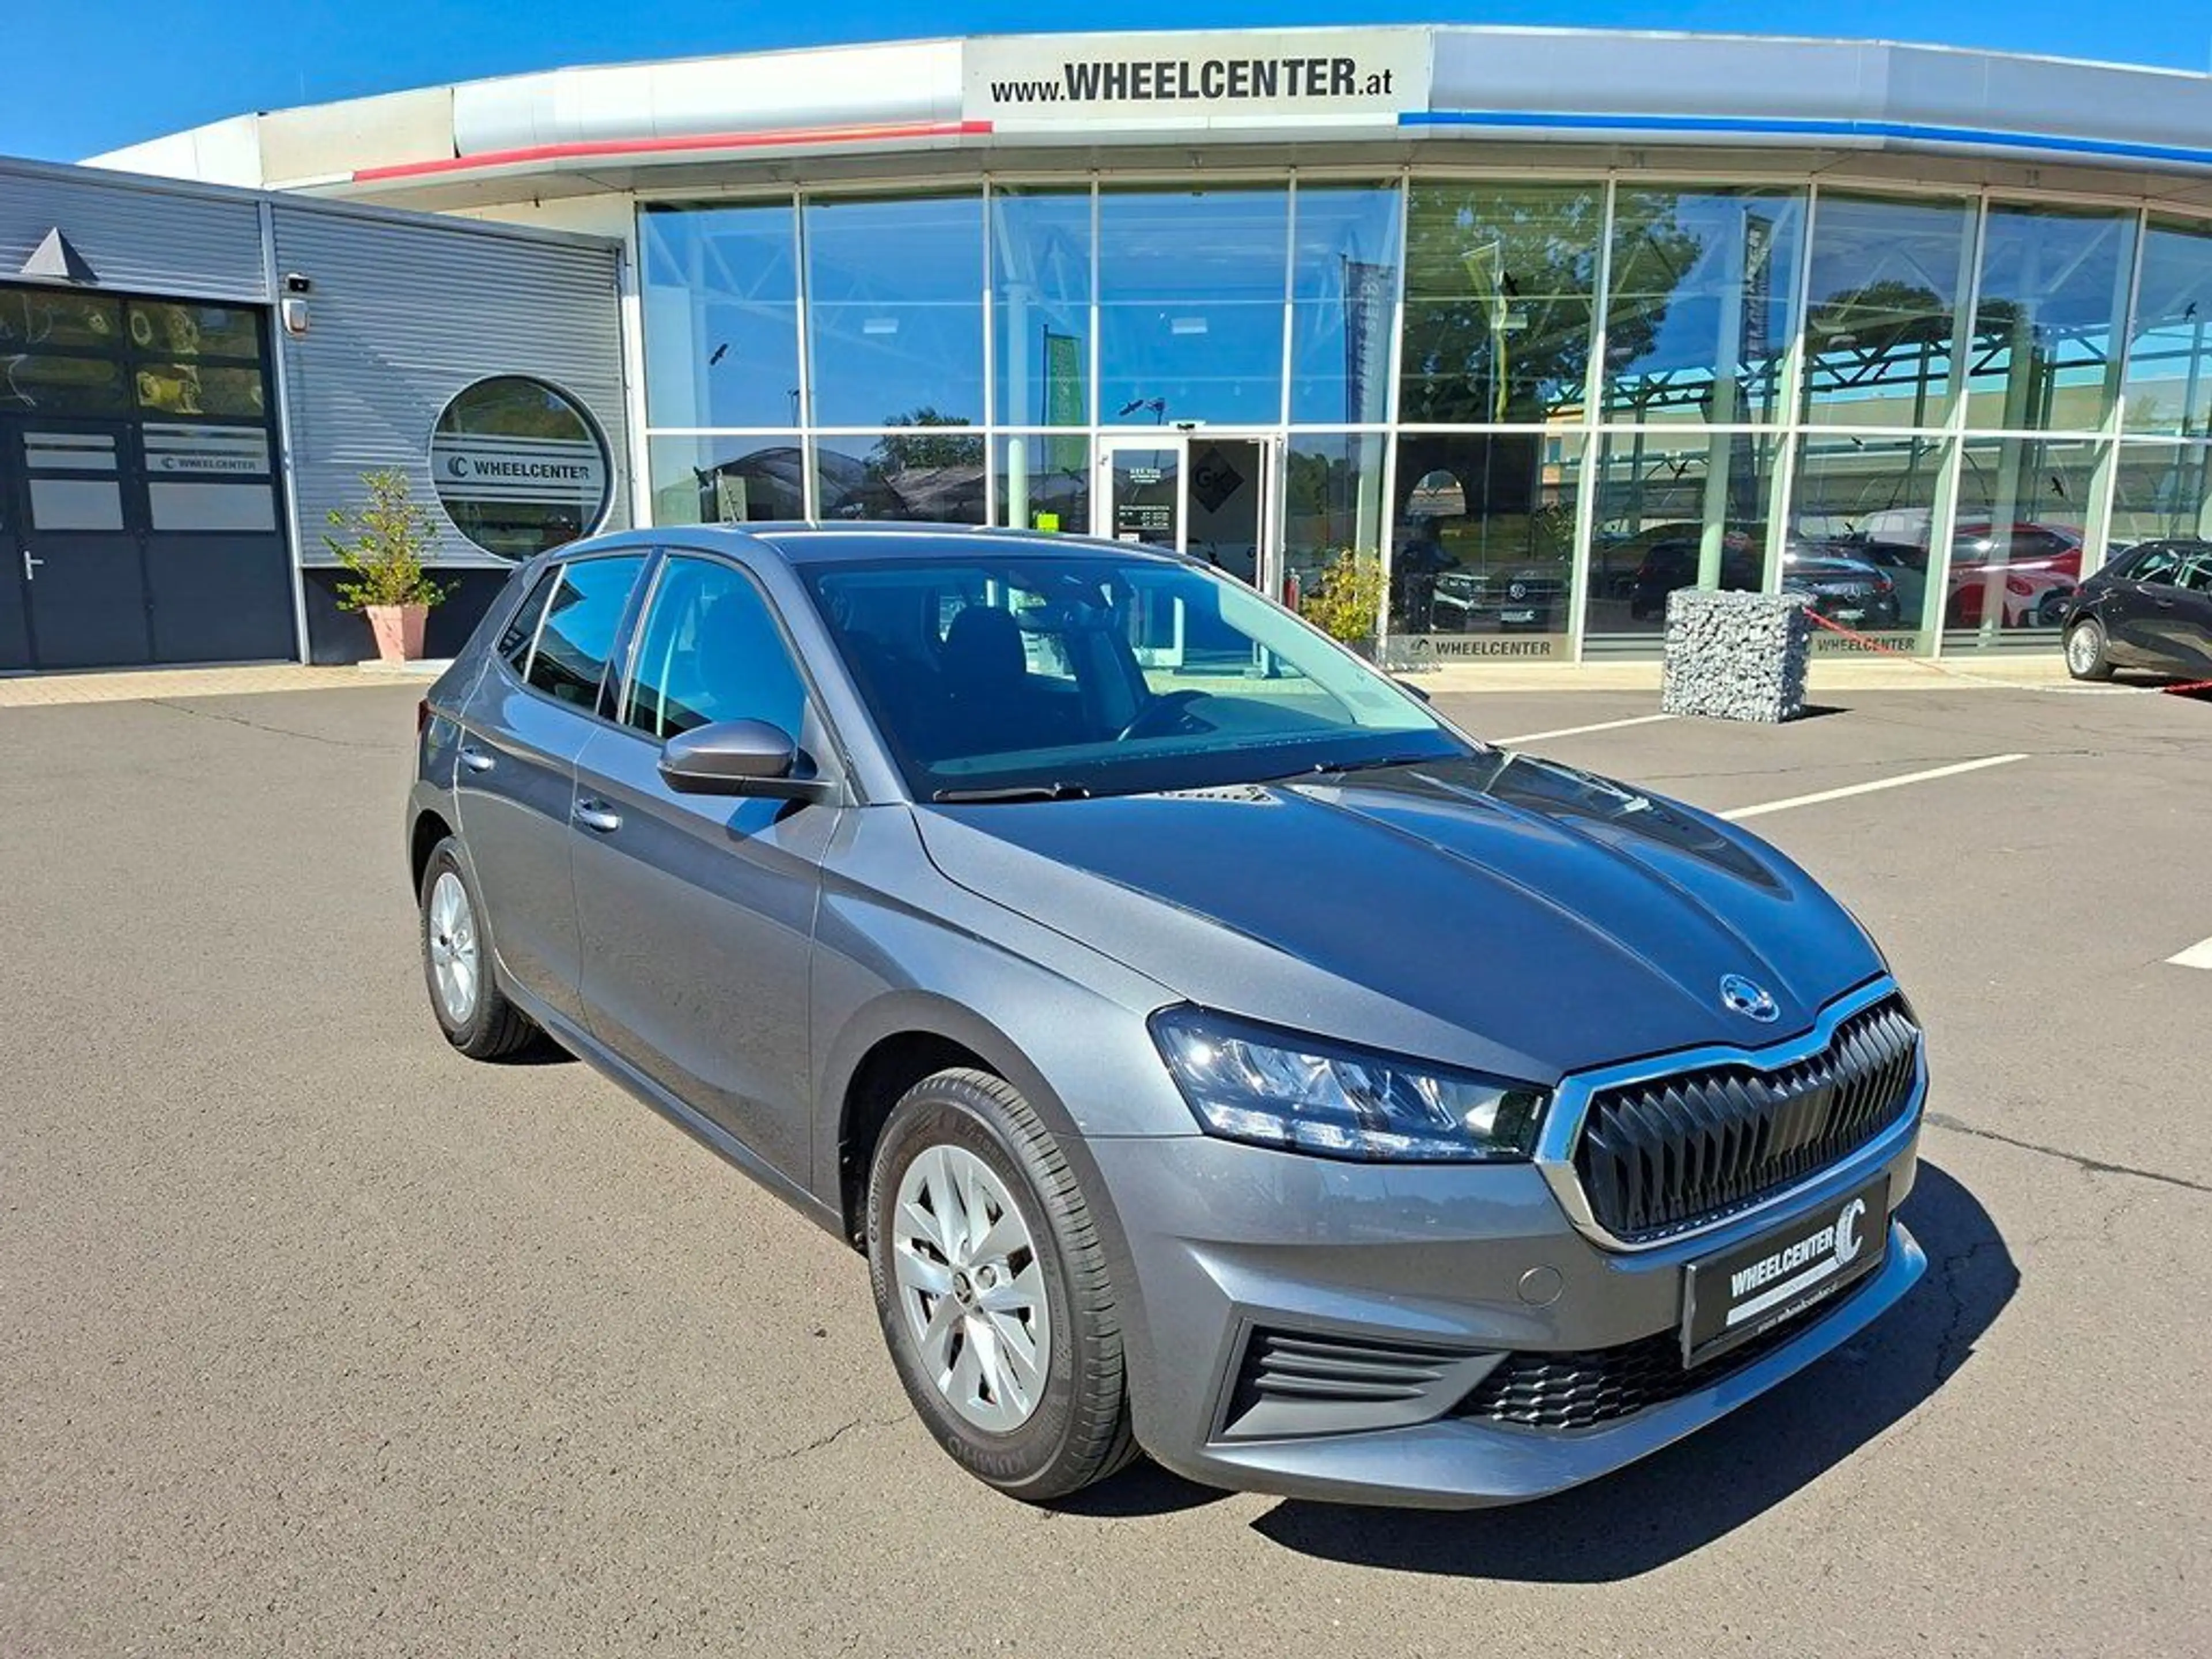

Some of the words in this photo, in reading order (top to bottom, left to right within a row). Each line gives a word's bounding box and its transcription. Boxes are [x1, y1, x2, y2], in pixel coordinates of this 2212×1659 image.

[991, 58, 1392, 103] www.WHEELCENTER.at
[473, 459, 590, 480] WHEELCENTER
[1435, 641, 1551, 656] WHEELCENTER
[1731, 1225, 1835, 1298] WHEELCENTER
